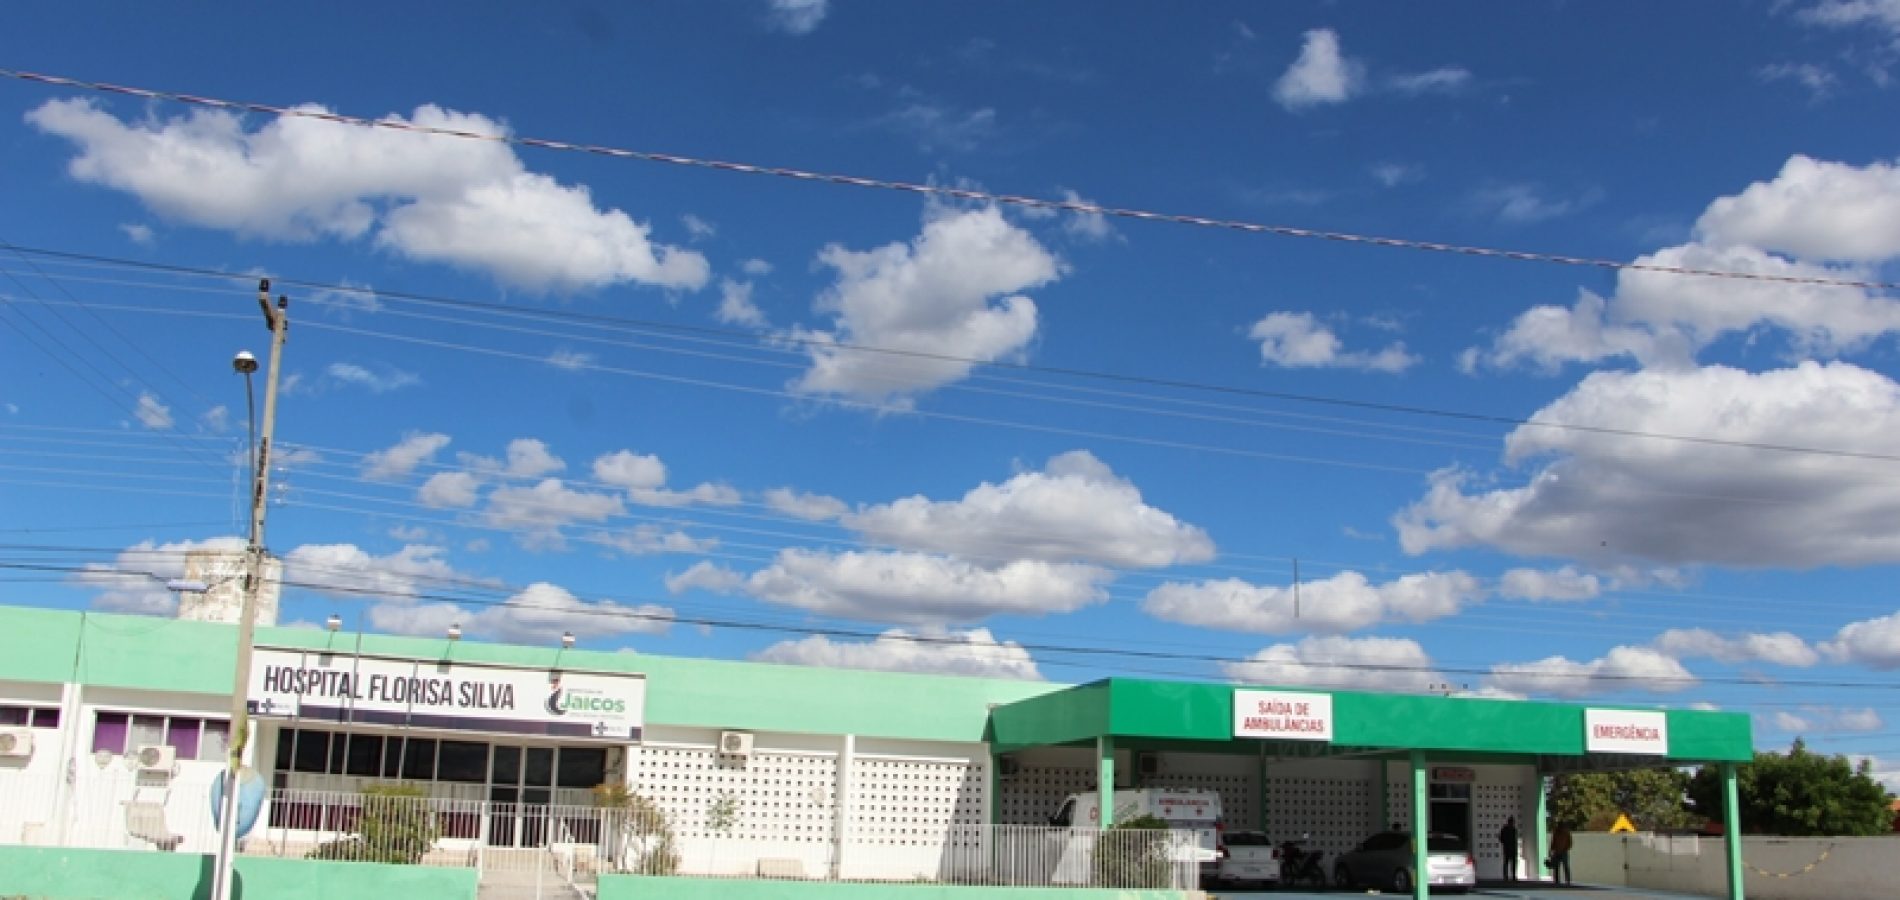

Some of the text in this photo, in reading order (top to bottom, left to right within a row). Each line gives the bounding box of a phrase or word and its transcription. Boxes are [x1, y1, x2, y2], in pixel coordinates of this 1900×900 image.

[264, 664, 514, 710] HOSPITAL FLORISA SILVA
[1258, 698, 1310, 715] SAÍDA DE
[1244, 713, 1324, 732] AMBULÂNCIAS
[1593, 723, 1660, 741] EMERGÊNCIA
